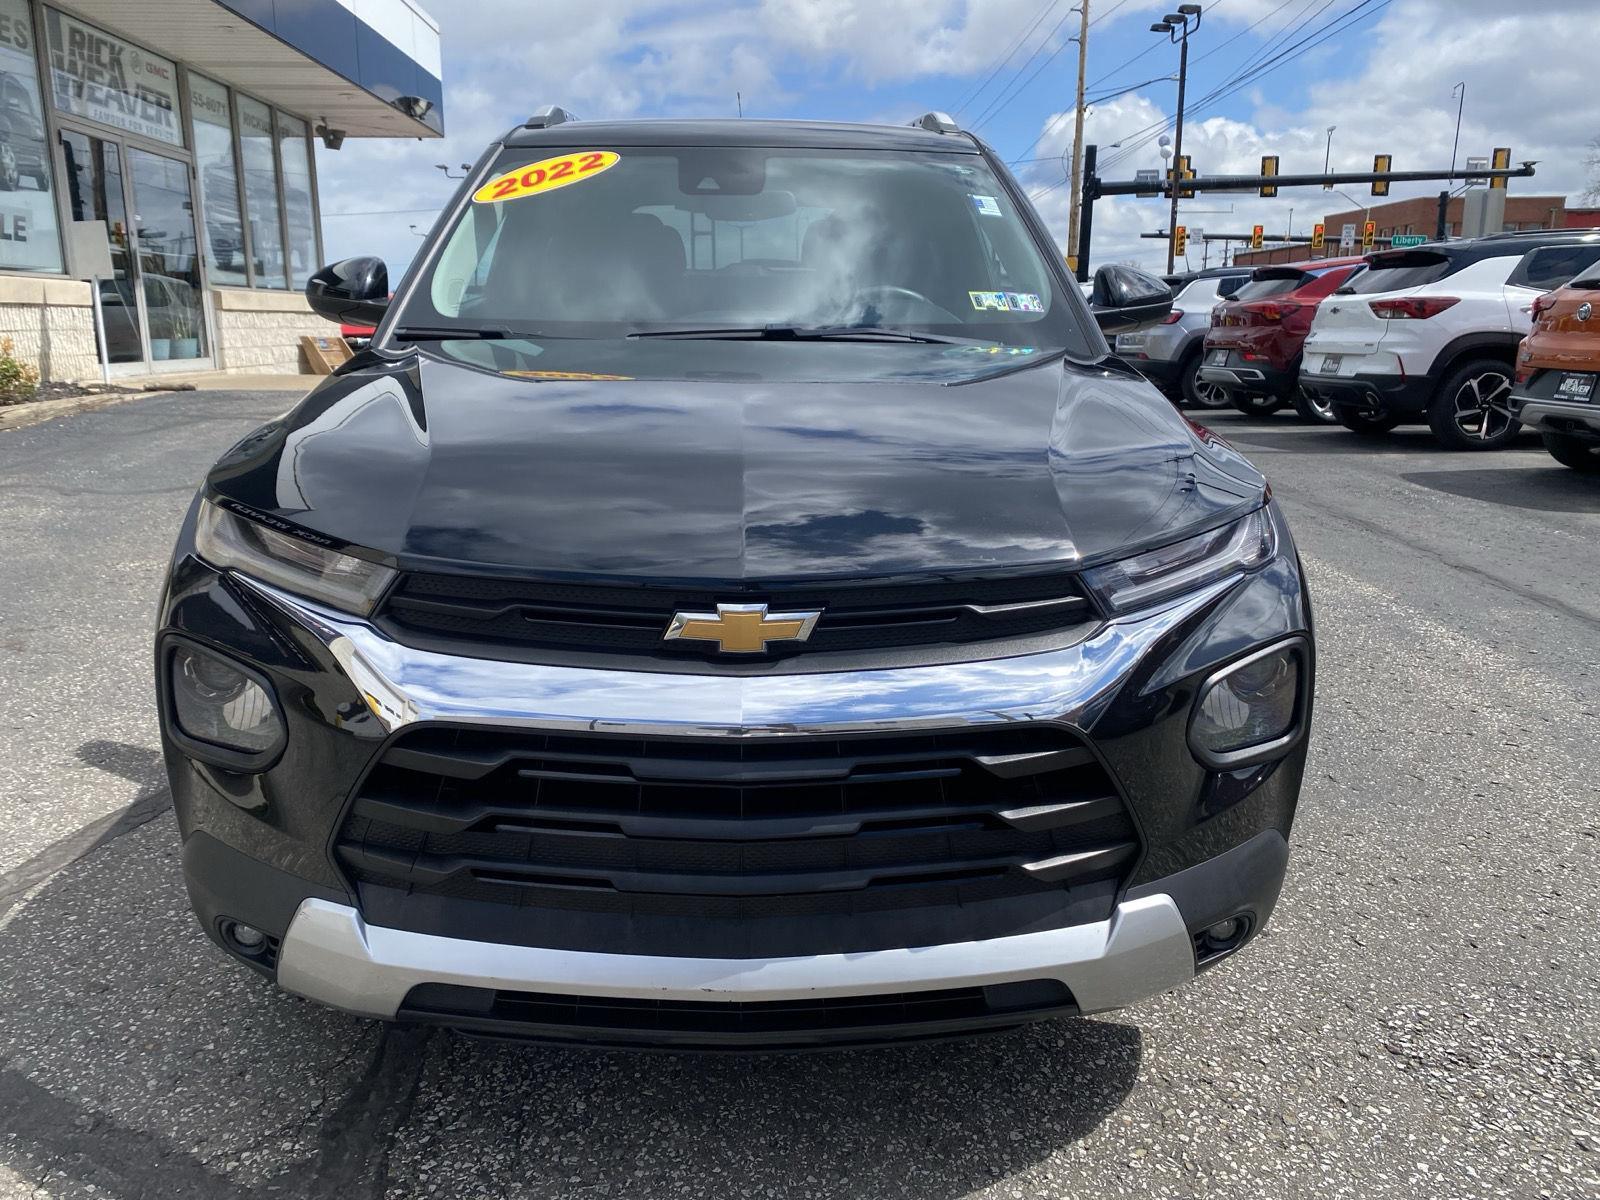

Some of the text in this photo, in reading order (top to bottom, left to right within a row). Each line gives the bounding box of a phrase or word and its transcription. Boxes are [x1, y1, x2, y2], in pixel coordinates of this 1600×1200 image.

[67, 25, 125, 71] RICK
[145, 61, 169, 80] GMC
[53, 50, 173, 129] WEAVER
[93, 107, 125, 127] FAMOUS
[492, 153, 604, 199] 2022
[0, 213, 27, 242] LE
[1395, 235, 1423, 245] Liberty
[1560, 382, 1590, 393] WEAVER
